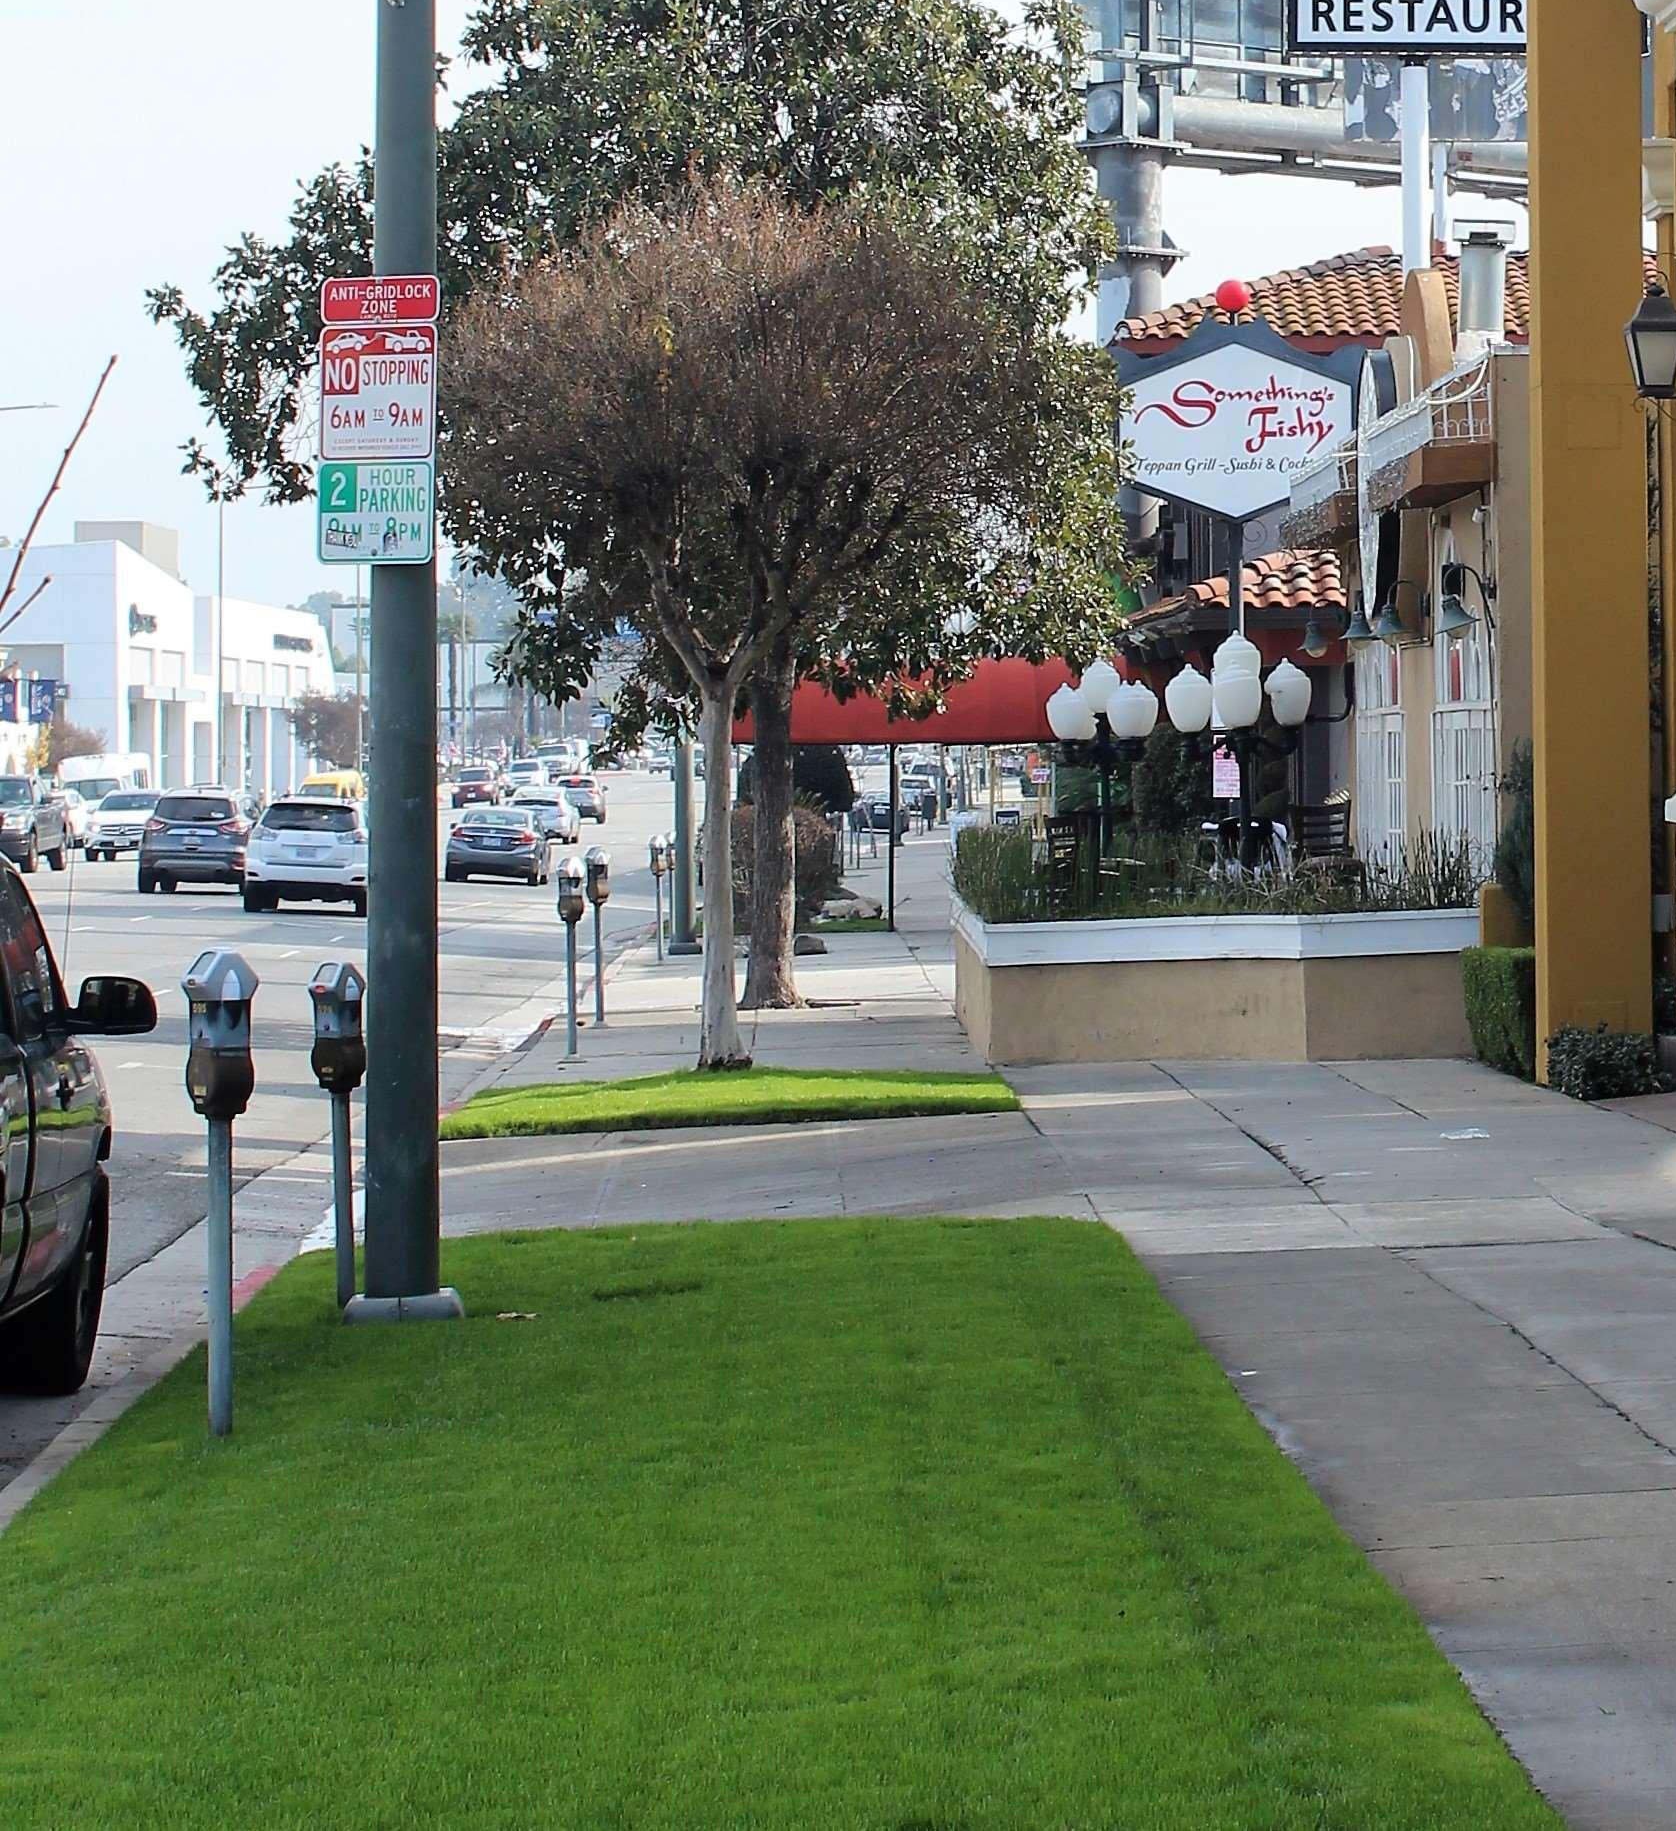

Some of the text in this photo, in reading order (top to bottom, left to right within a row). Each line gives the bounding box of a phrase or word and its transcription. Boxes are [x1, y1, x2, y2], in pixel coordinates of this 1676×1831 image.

[329, 284, 432, 301] ANTI-GRIDLOCK
[360, 299, 398, 314] ZONE
[325, 357, 429, 391] NO STOPPING
[1135, 375, 1335, 428] Something's
[331, 402, 423, 429] 6AM TO 9AM
[1245, 406, 1335, 454] Fishy
[1136, 457, 1182, 475] Teppan
[1184, 457, 1217, 476] Grill
[1266, 457, 1276, 470] &
[330, 468, 416, 507] 2 HOUR
[359, 486, 426, 513] PARKING
